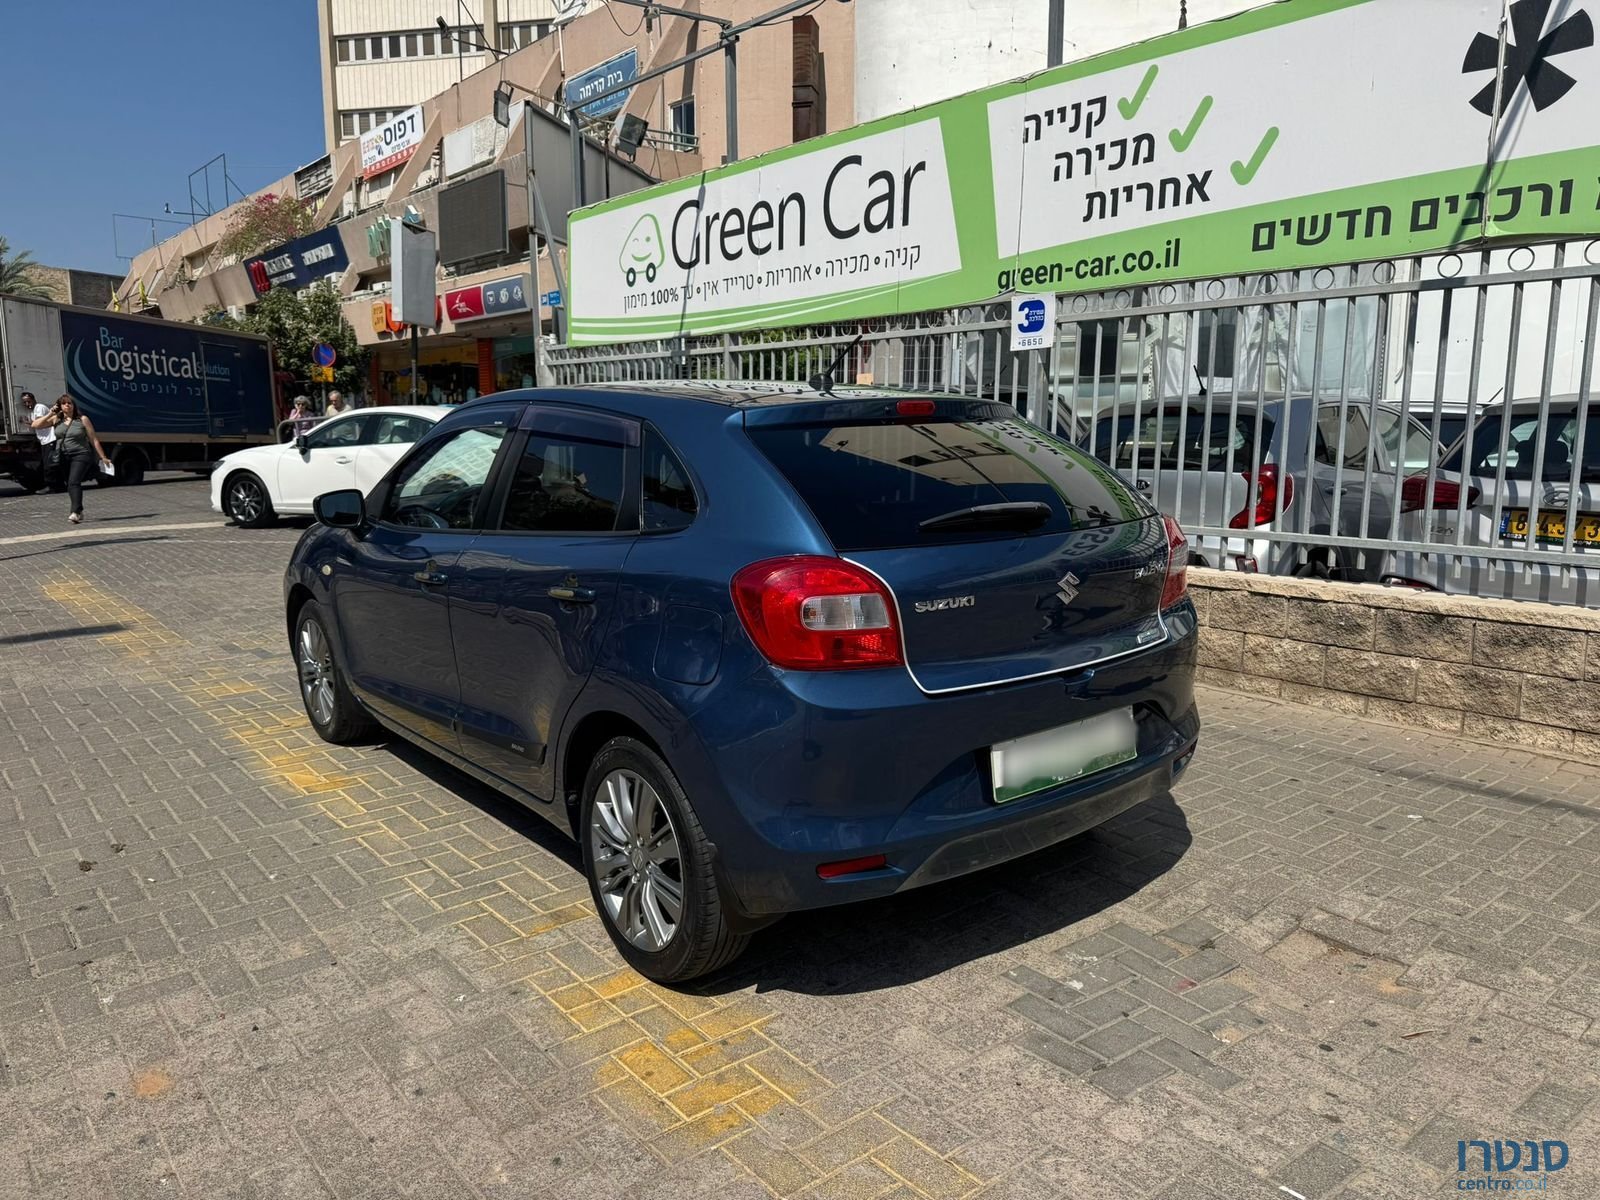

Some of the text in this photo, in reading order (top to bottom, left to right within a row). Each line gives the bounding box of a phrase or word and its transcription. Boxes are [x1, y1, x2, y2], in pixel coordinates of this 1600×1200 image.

[579, 77, 605, 100] קדימה
[607, 70, 623, 87] בית
[383, 113, 415, 146] דפוס
[1023, 95, 1107, 144] קנייה
[1053, 132, 1155, 182] מכירה
[1082, 169, 1213, 223] אחריות
[1409, 178, 1574, 233] ורכבים
[671, 154, 926, 270] Green Car
[1251, 204, 1392, 252] חדשים
[824, 252, 870, 279] מכירה
[884, 244, 922, 272] קניה
[997, 238, 1181, 293] green-car.co.il
[723, 272, 754, 295] טרייד
[765, 263, 812, 288] אחריות
[624, 291, 648, 314] מימון
[650, 286, 679, 305] 100%
[703, 278, 719, 301] אין
[99, 326, 124, 349] Bar
[96, 339, 200, 381] logistical
[914, 594, 976, 613] SUZUKI
